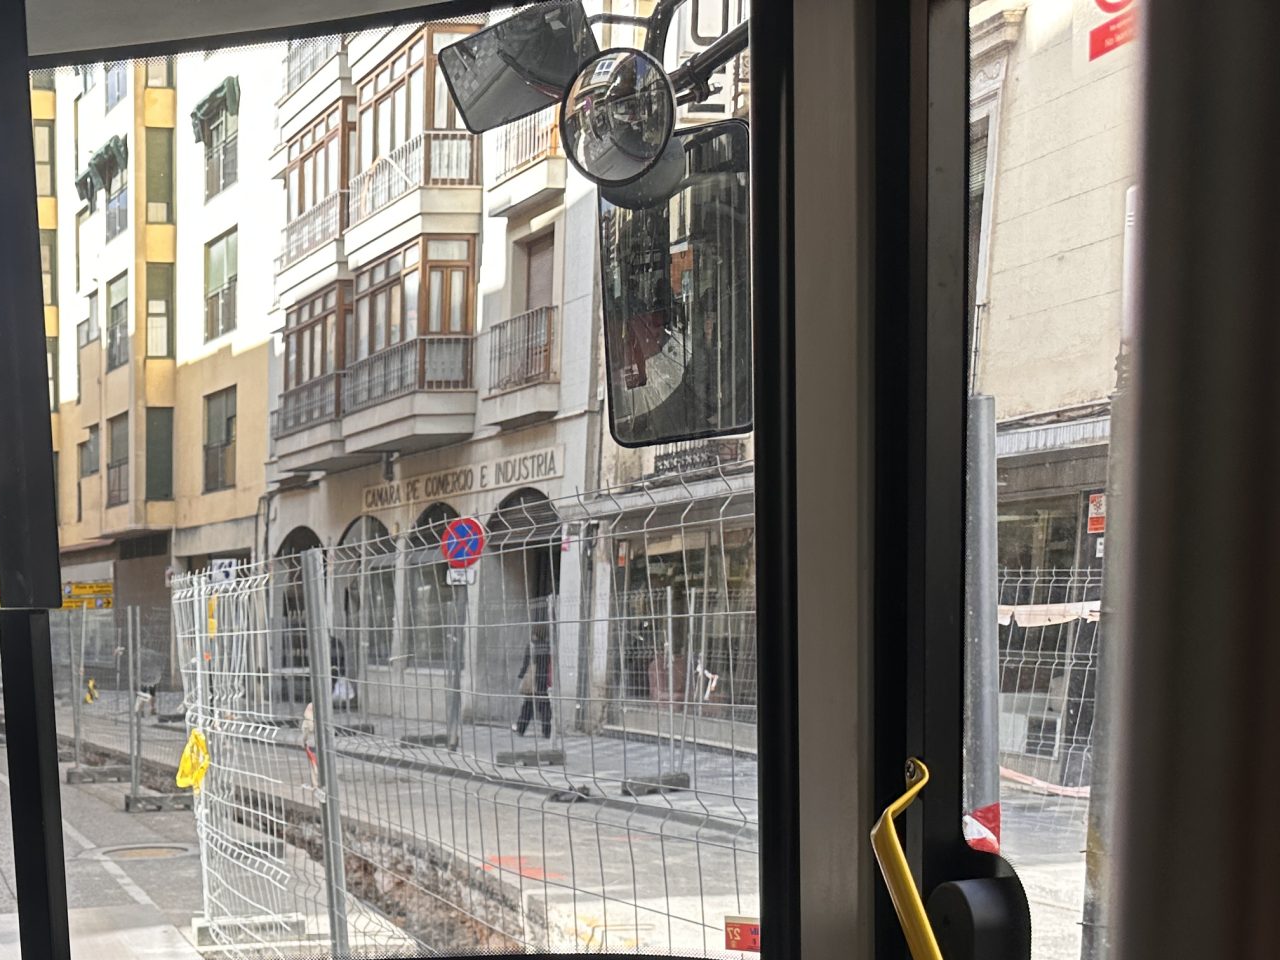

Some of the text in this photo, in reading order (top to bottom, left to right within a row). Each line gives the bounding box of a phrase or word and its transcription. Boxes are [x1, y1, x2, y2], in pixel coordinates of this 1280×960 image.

[424, 468, 474, 498] COMERCIO
[480, 464, 488, 488] E
[494, 449, 557, 485] INDUSTRIA
